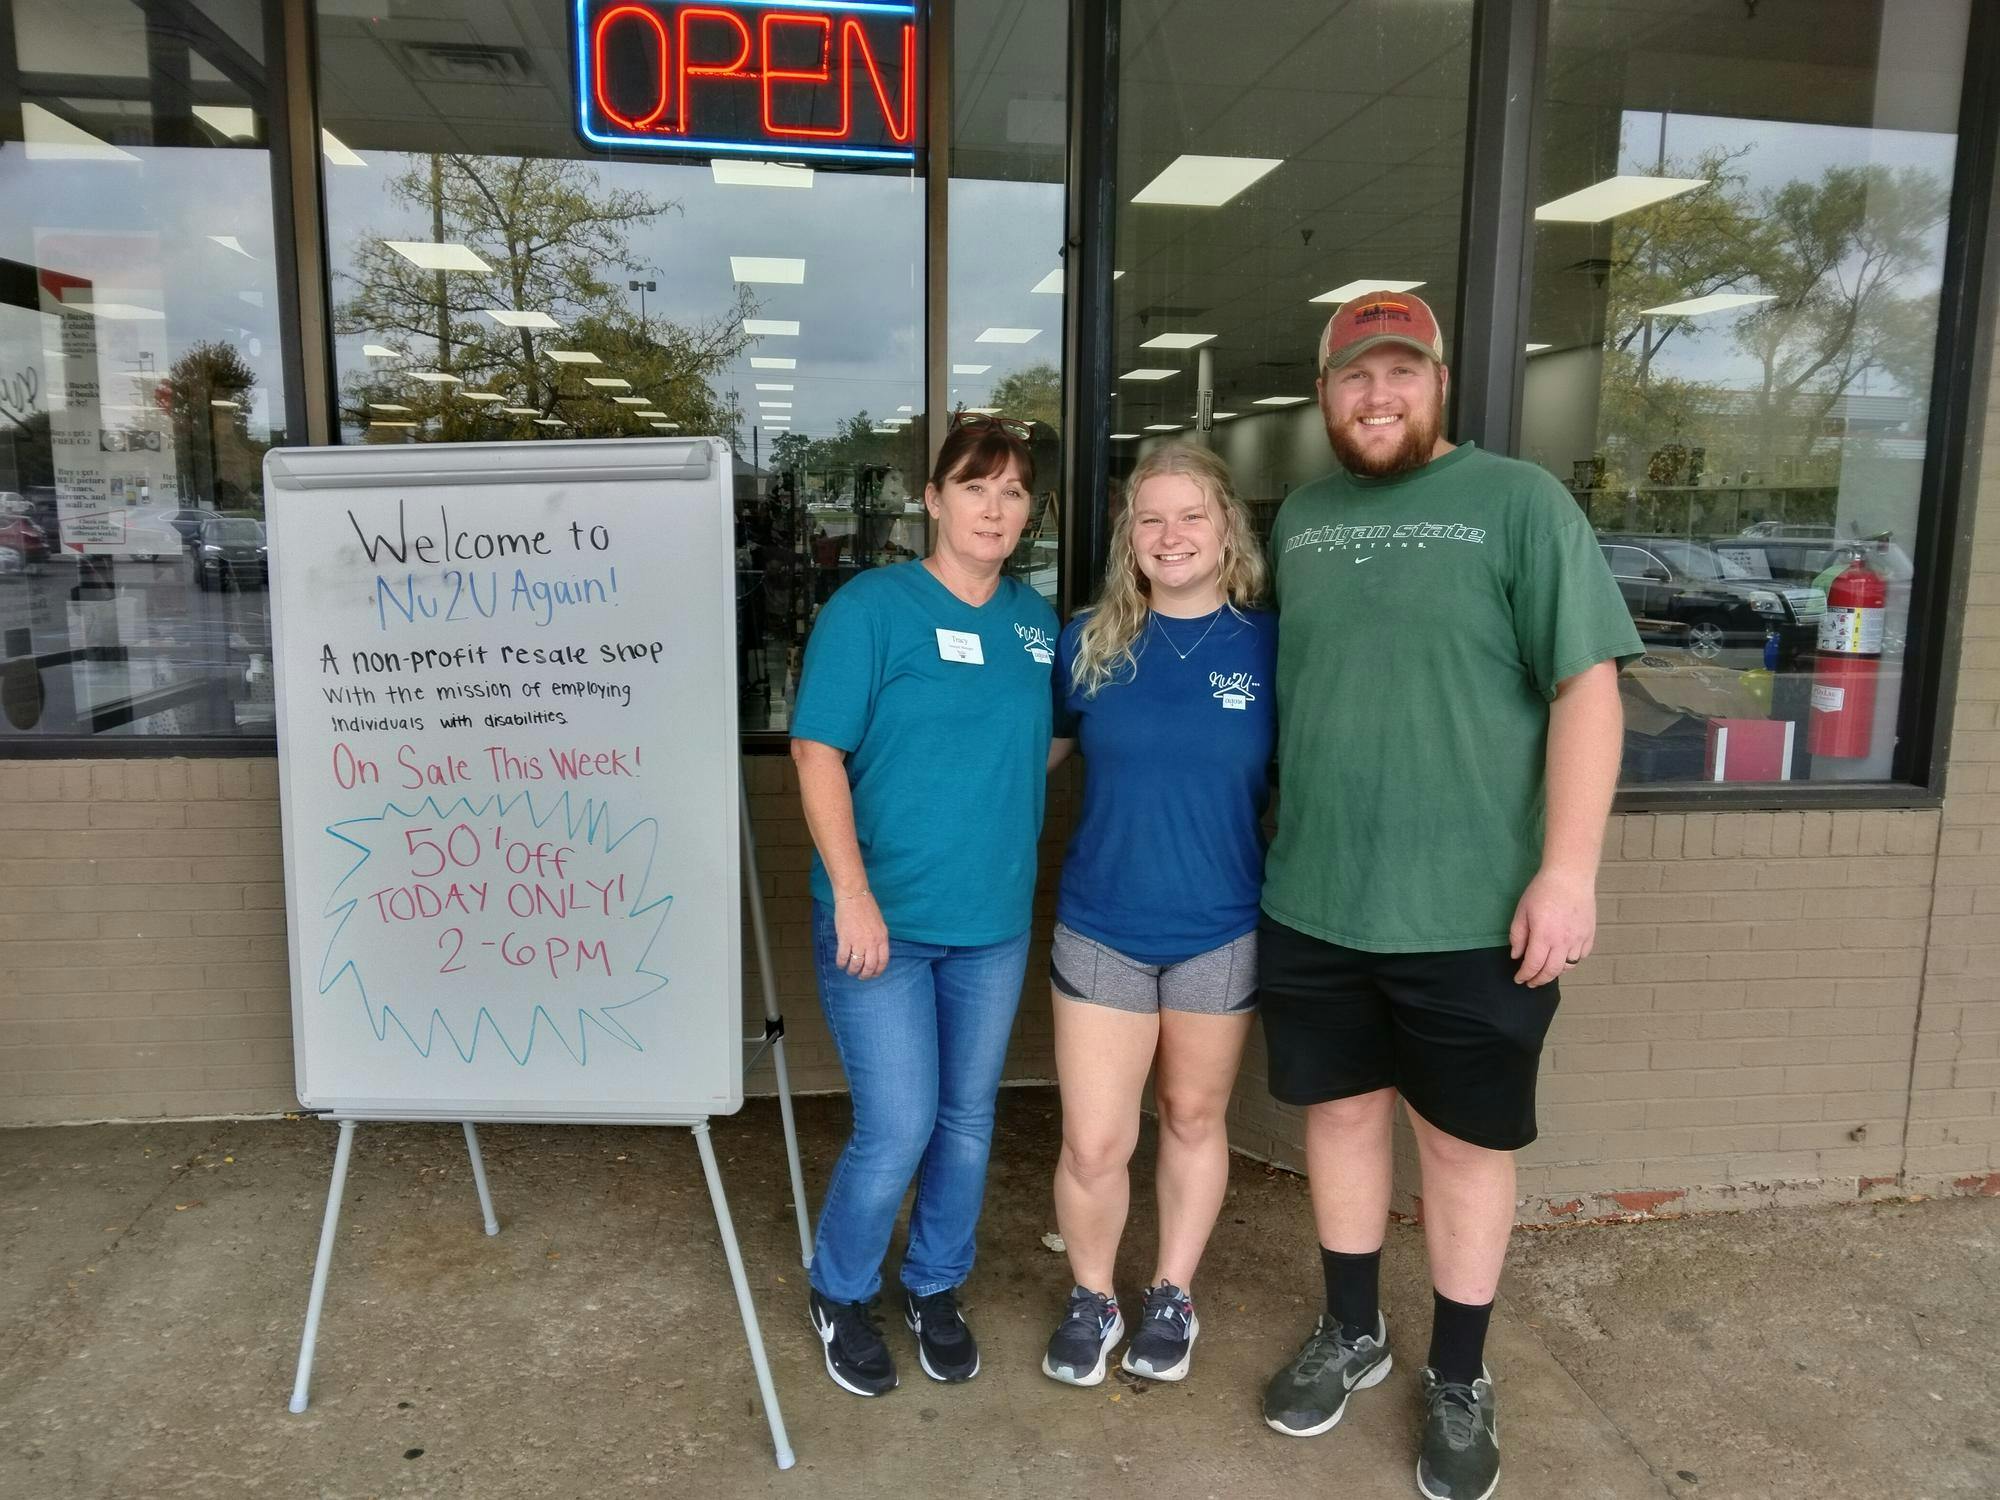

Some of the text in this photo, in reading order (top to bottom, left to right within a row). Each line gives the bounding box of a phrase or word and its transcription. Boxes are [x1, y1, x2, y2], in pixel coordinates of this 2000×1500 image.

[596, 6, 914, 141] OPEN
[347, 499, 610, 565] Welcome to
[1285, 522, 1486, 552] michigan state
[376, 565, 619, 632] Nu2U Again!
[320, 640, 664, 676] A non-profit resale shop
[385, 683, 425, 703] the
[436, 681, 511, 700] mission
[521, 682, 542, 699] of
[551, 680, 632, 707] employing
[439, 712, 473, 730] with
[484, 710, 568, 728] disabilities
[332, 742, 642, 791] On Sale This Week!
[505, 842, 575, 880] Off
[367, 874, 625, 924] TODAY ONLY!
